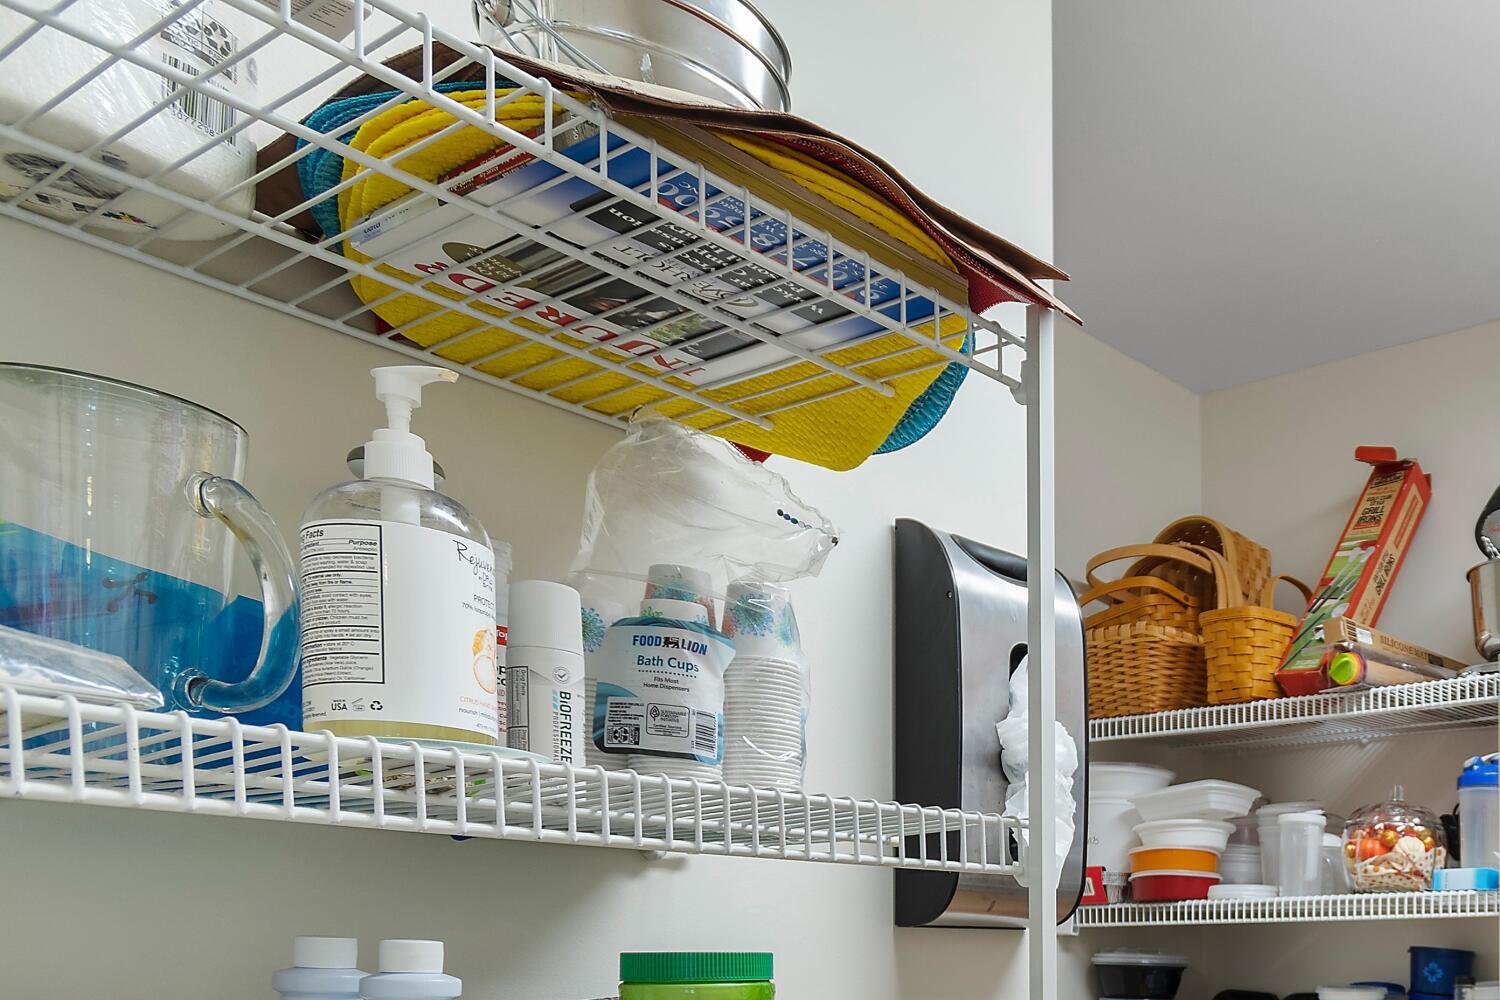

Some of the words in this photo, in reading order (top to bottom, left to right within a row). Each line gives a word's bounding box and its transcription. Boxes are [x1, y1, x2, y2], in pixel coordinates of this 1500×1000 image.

[306, 529, 324, 539] Facts
[632, 635, 661, 646] FOOD
[681, 639, 707, 655] LION
[1380, 635, 1415, 656] SILICONE
[637, 655, 663, 666] Bath
[668, 657, 699, 672] Cups
[660, 683, 689, 692] Dispensers
[331, 703, 348, 711] USA
[560, 691, 572, 765] BIOFREEZE
